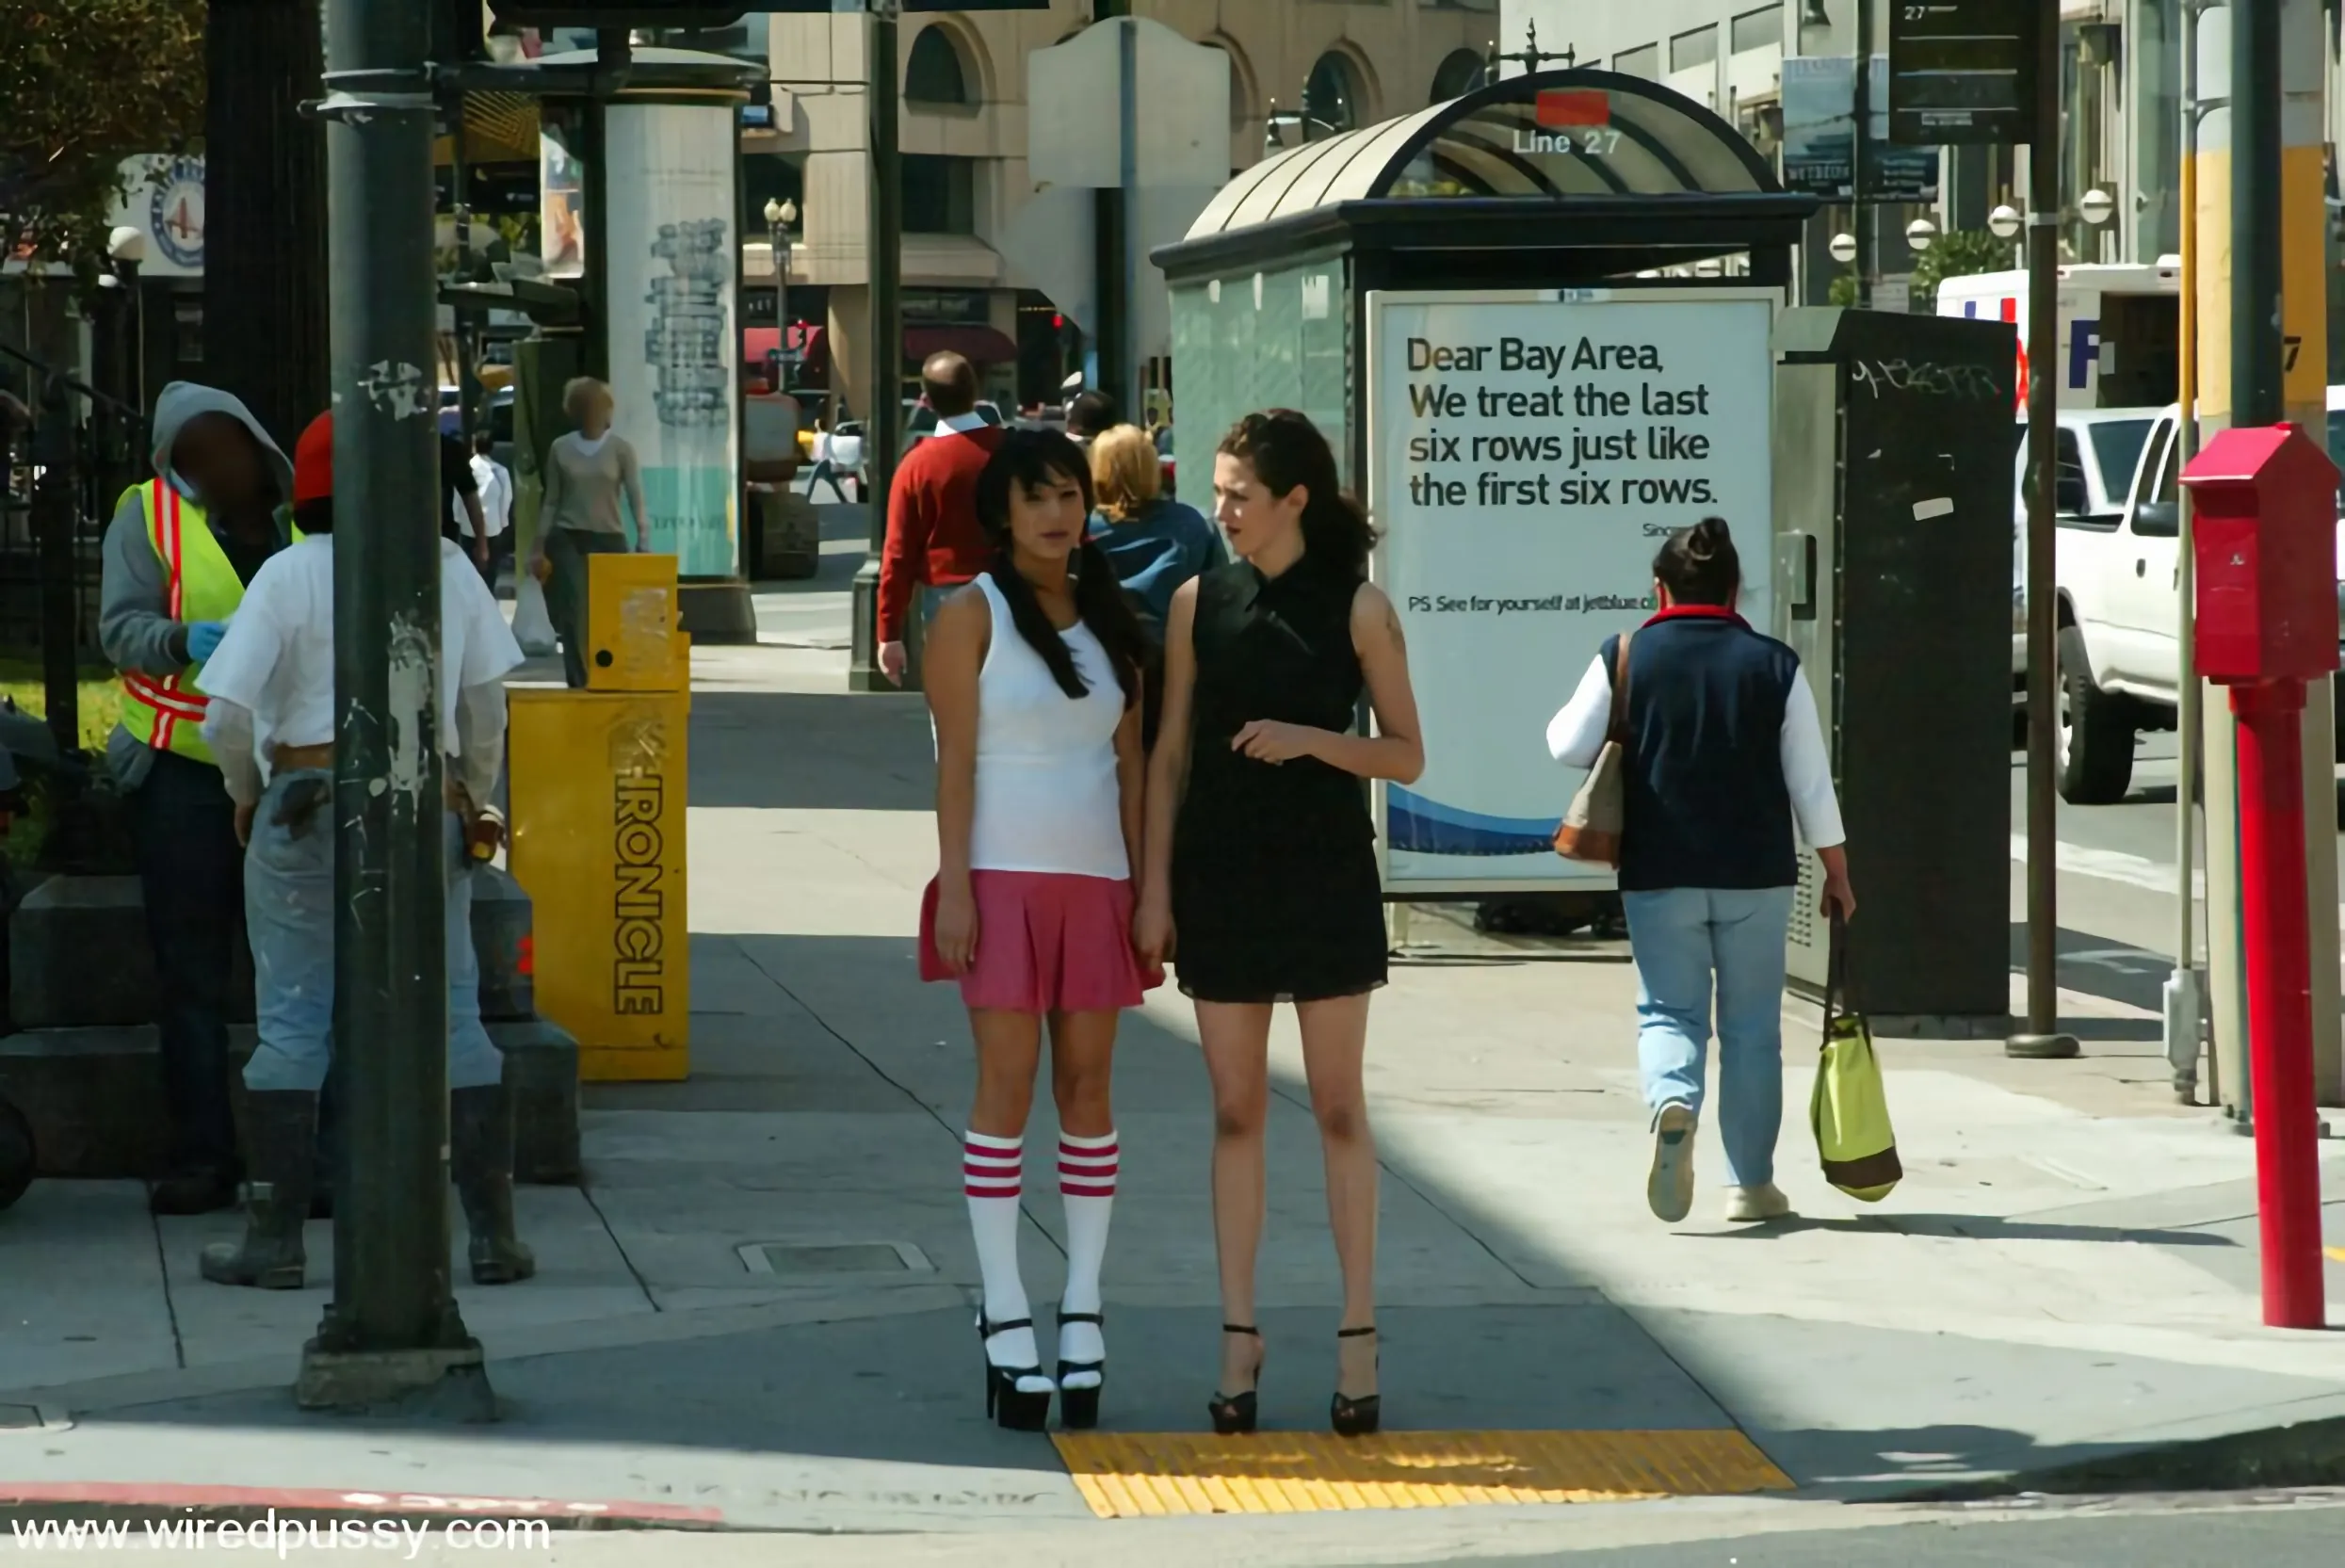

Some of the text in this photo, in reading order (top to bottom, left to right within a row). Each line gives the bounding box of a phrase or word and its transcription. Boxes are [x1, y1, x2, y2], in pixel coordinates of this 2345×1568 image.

[1904, 6, 1925, 21] 27
[1512, 129, 1622, 154] Line 27
[1407, 336, 1664, 379] Dear Bay Area,
[1408, 381, 1709, 417] We treat the last
[1409, 426, 1710, 469] six rows just like
[1409, 470, 1718, 506] the first six rows.
[1436, 595, 1468, 612] See
[1470, 594, 1495, 611] for
[1496, 594, 1562, 616] yourself
[1564, 595, 1580, 611] at
[614, 720, 663, 1015] RONICLE
